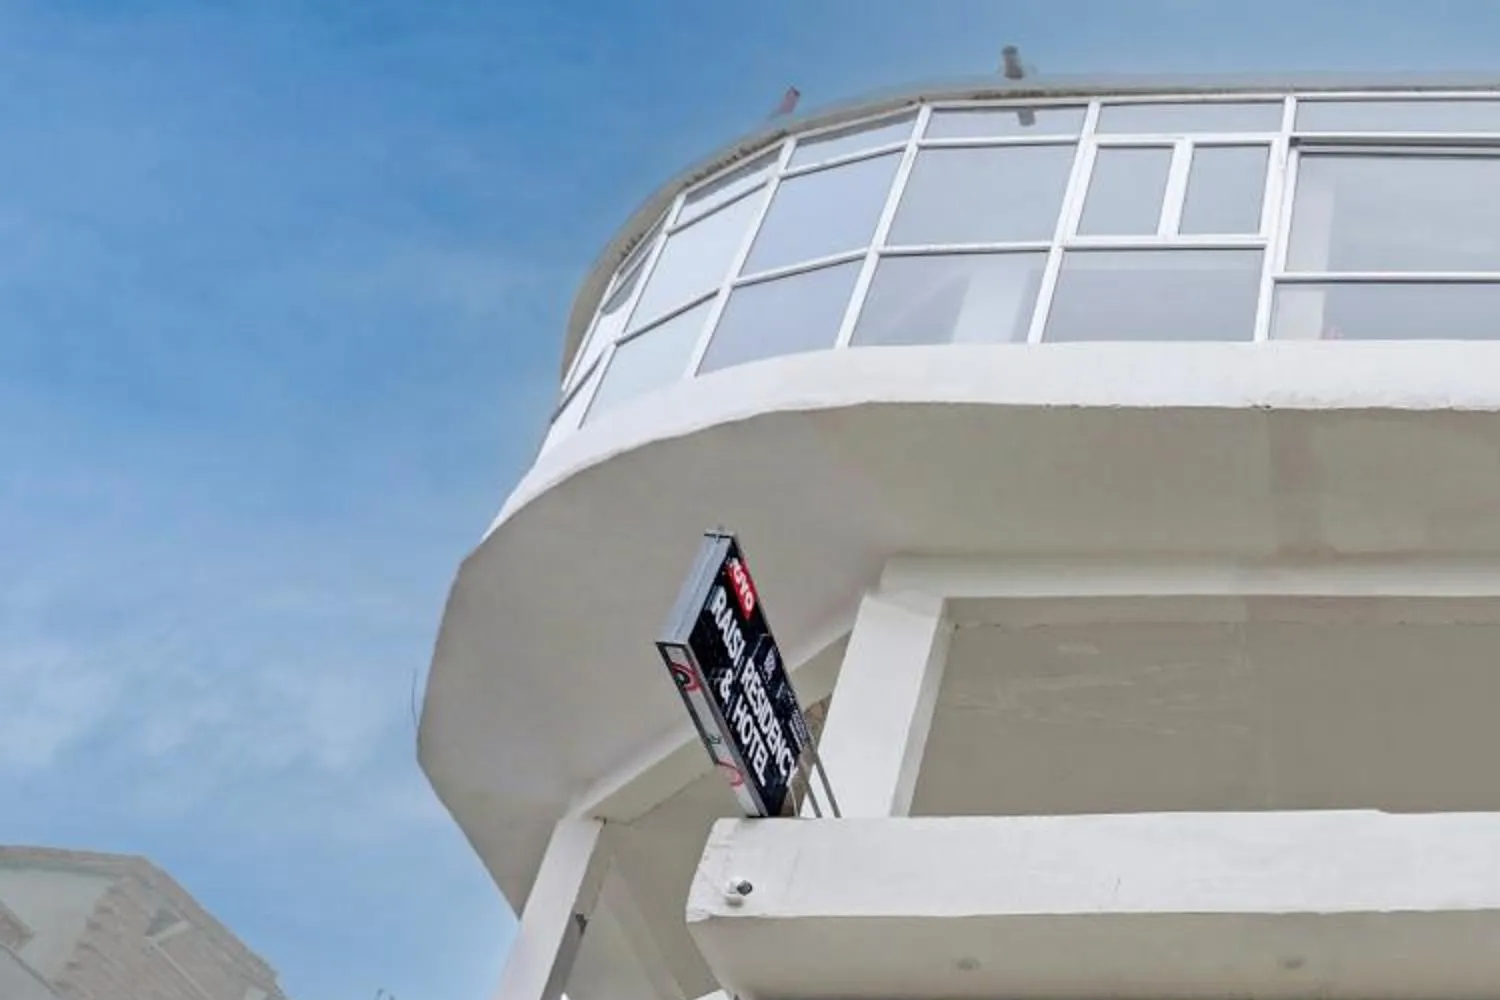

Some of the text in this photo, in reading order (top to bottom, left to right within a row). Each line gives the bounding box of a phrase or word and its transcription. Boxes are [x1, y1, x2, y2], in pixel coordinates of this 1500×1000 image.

[711, 584, 746, 668] RAISI
[719, 668, 768, 787] & HOTEL
[741, 657, 799, 788] RESIDENCY
